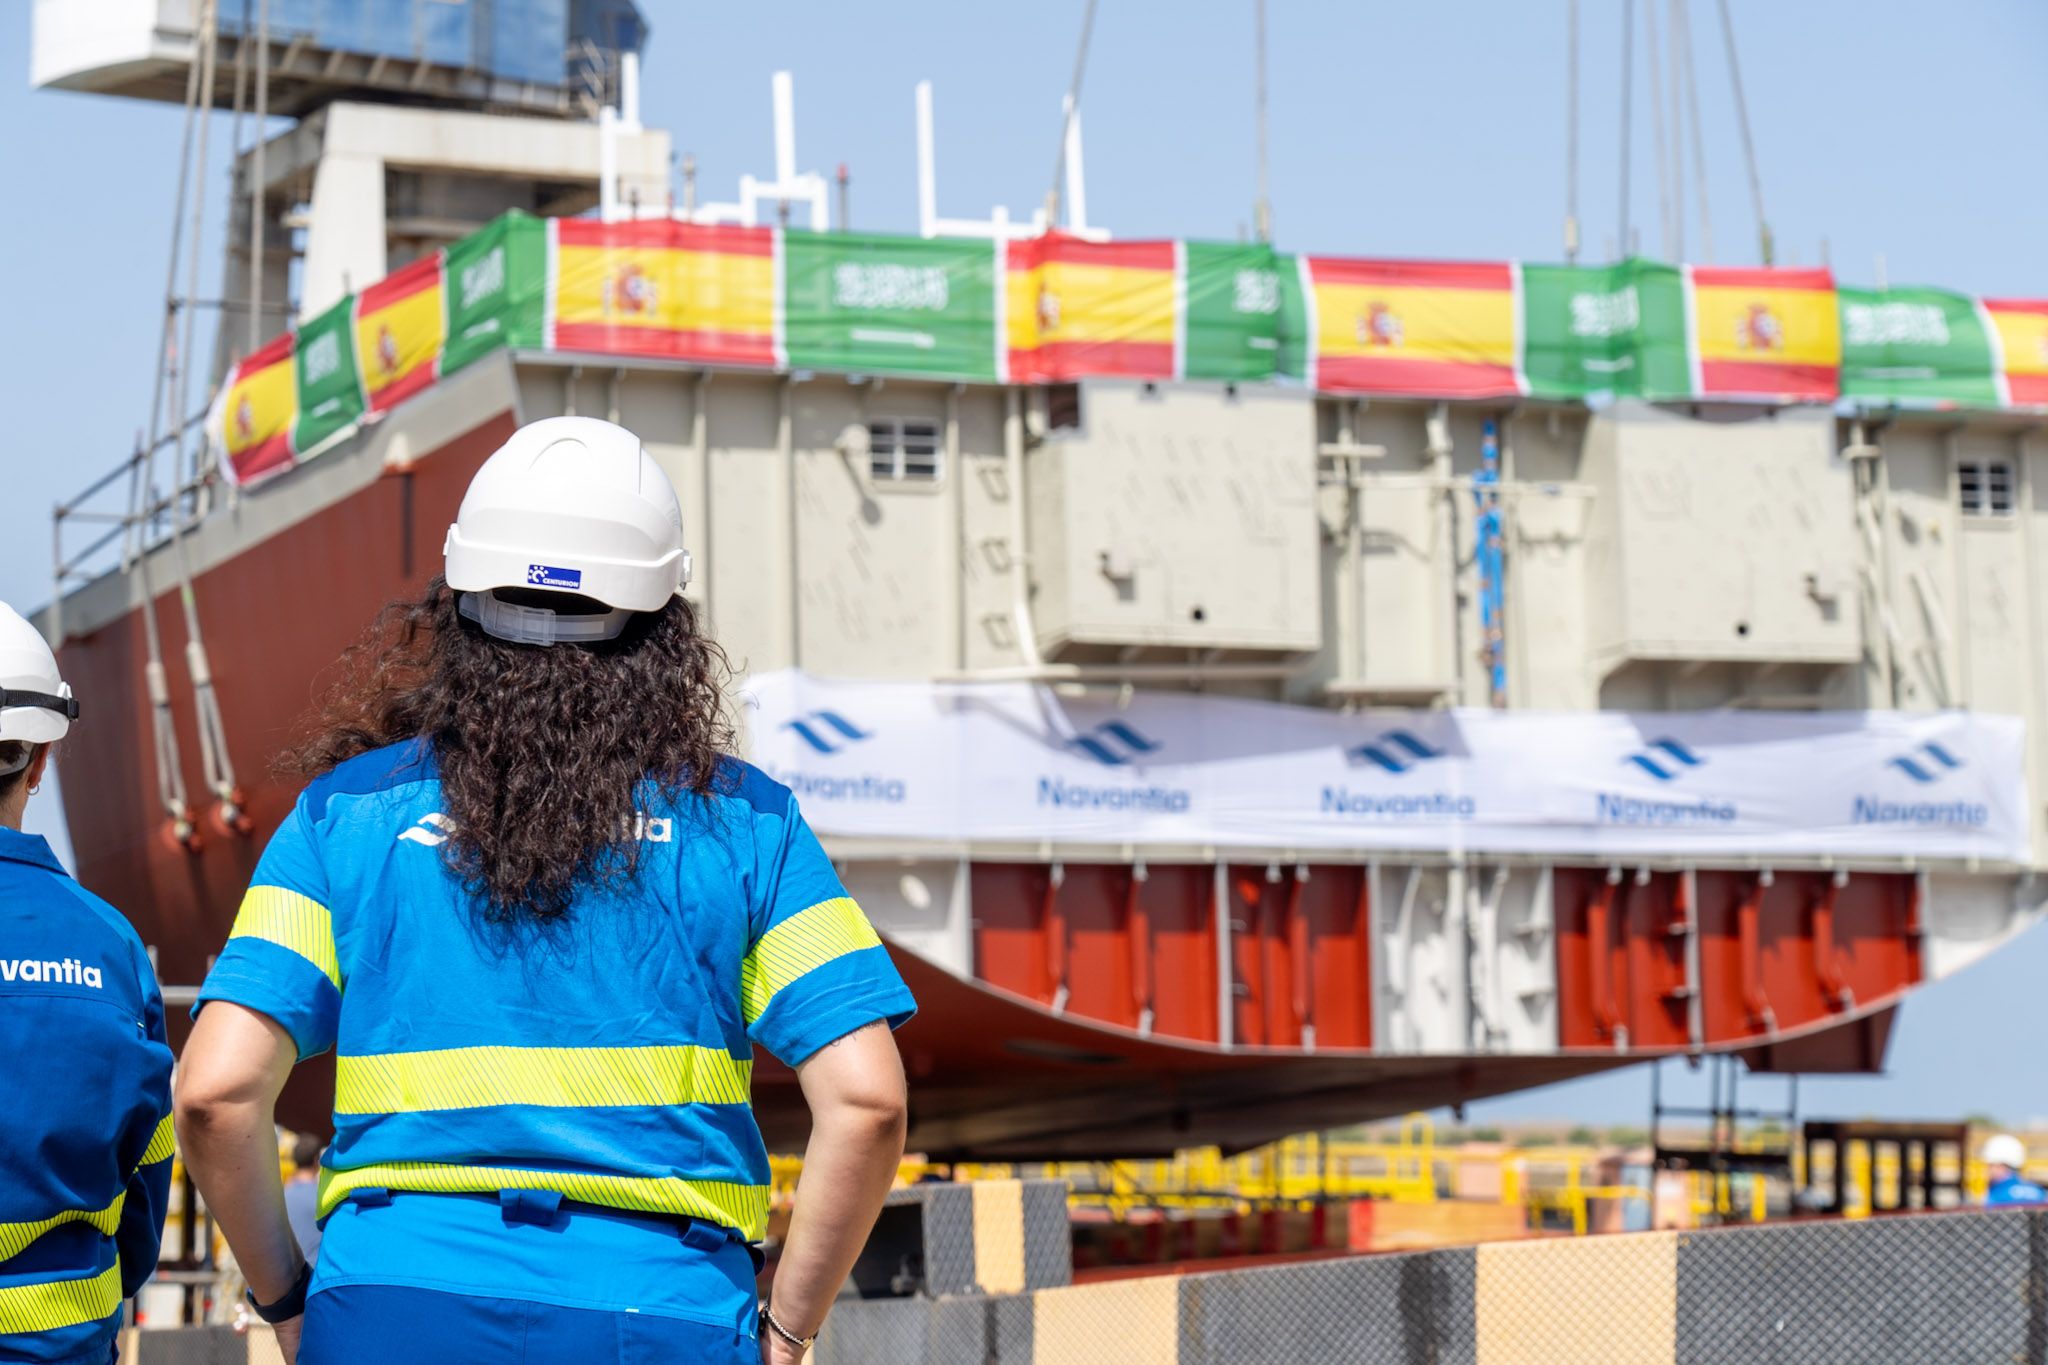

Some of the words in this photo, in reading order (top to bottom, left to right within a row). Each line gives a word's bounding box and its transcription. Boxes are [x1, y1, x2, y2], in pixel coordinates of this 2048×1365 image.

[543, 577, 579, 588] CENTURION
[767, 763, 906, 802] avantia
[1037, 775, 1191, 812] Navantia
[1321, 785, 1475, 819] Navantia
[1855, 795, 1989, 825] Navantia
[0, 958, 103, 989] vantia
